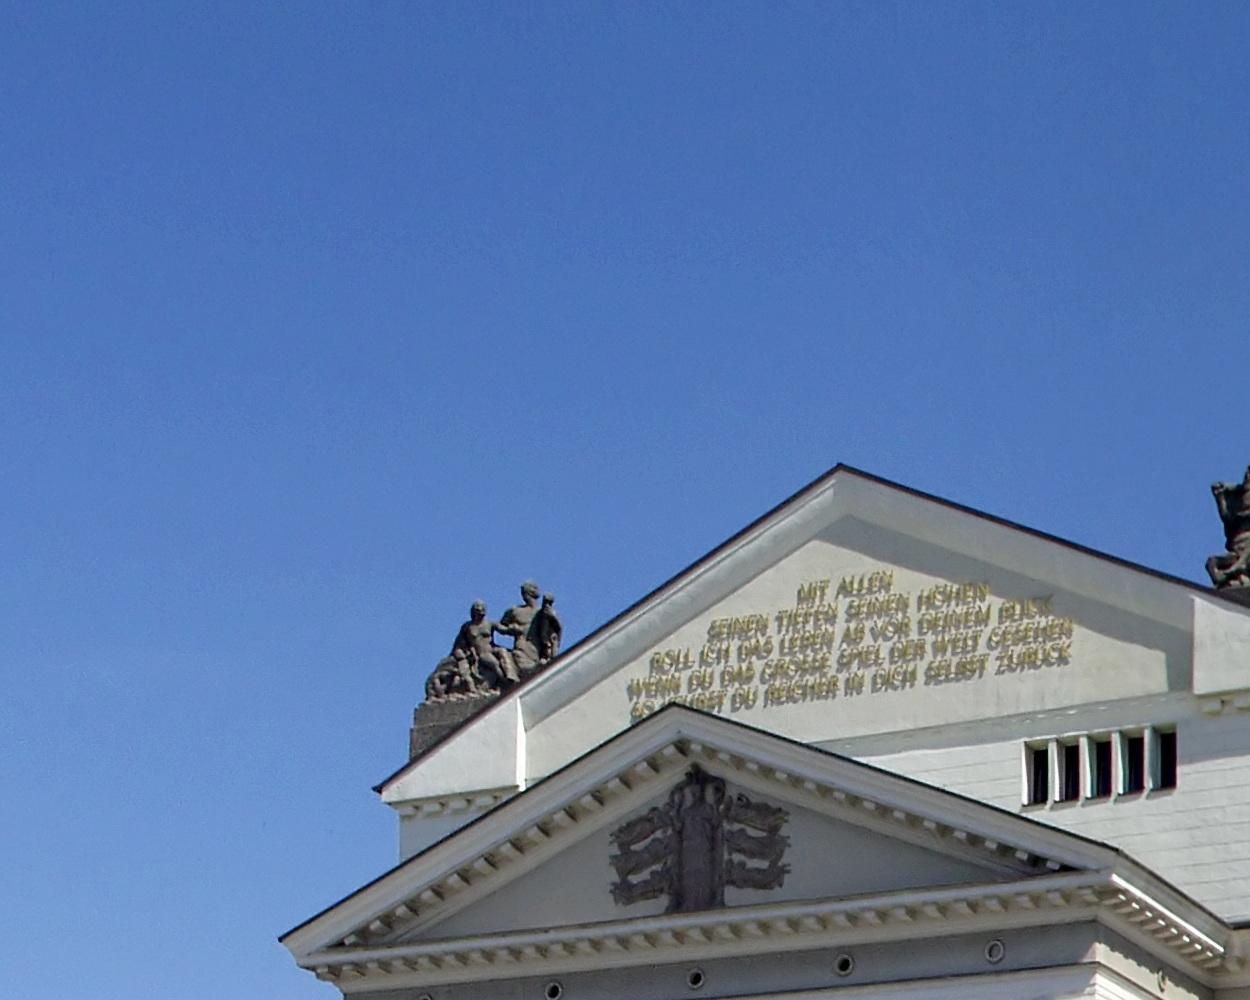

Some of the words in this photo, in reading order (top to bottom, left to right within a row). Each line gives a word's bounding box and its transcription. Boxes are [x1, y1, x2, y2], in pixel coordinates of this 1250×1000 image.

[799, 580, 830, 602] MIT
[838, 570, 894, 595] ALLEN
[651, 647, 695, 671] ROLL
[701, 641, 731, 665] ICH
[738, 635, 773, 661] DAS
[780, 627, 835, 653] LEBEN
[842, 621, 865, 647] AB
[870, 615, 912, 640] VOR
[918, 604, 991, 633] DEINEM
[999, 594, 1053, 623] BLICK
[709, 614, 769, 639] SEINEN
[777, 603, 838, 630] TIEFEN
[847, 593, 910, 619] SEINEN
[628, 672, 681, 698] WENN
[689, 668, 714, 691] DU
[721, 661, 755, 687] DAS
[838, 645, 885, 670] SPIEL
[890, 639, 927, 663] DER
[932, 630, 983, 657] WELT
[987, 616, 1074, 648] GESEHEN
[732, 686, 758, 710] DU
[765, 675, 839, 703] REICHER
[845, 671, 865, 695] IN
[872, 663, 917, 692] DICH
[925, 653, 990, 684] SELBST
